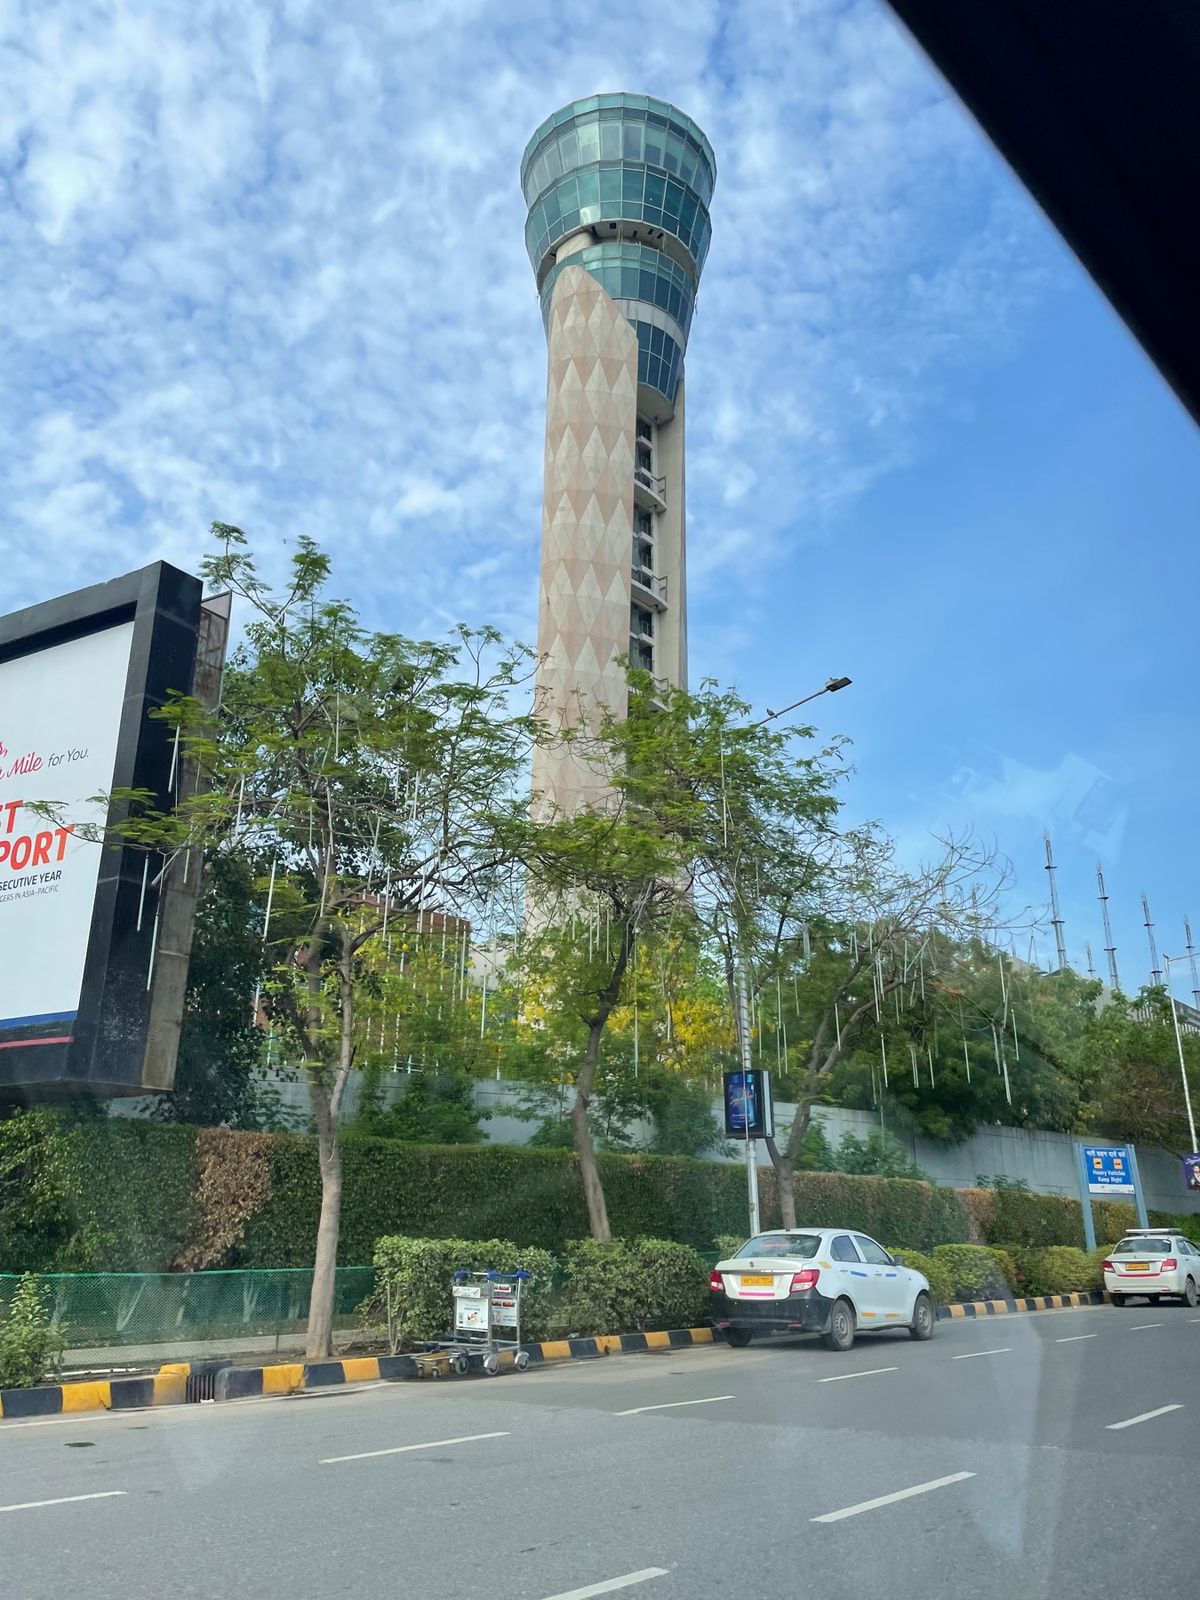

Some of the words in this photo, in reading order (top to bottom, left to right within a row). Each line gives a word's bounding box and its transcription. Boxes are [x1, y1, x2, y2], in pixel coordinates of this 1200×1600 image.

[7, 752, 43, 777] Mile
[48, 753, 65, 767] for
[67, 749, 89, 762] You.
[40, 869, 62, 883] YEAR
[22, 884, 59, 897] ASIA-PACIFIC
